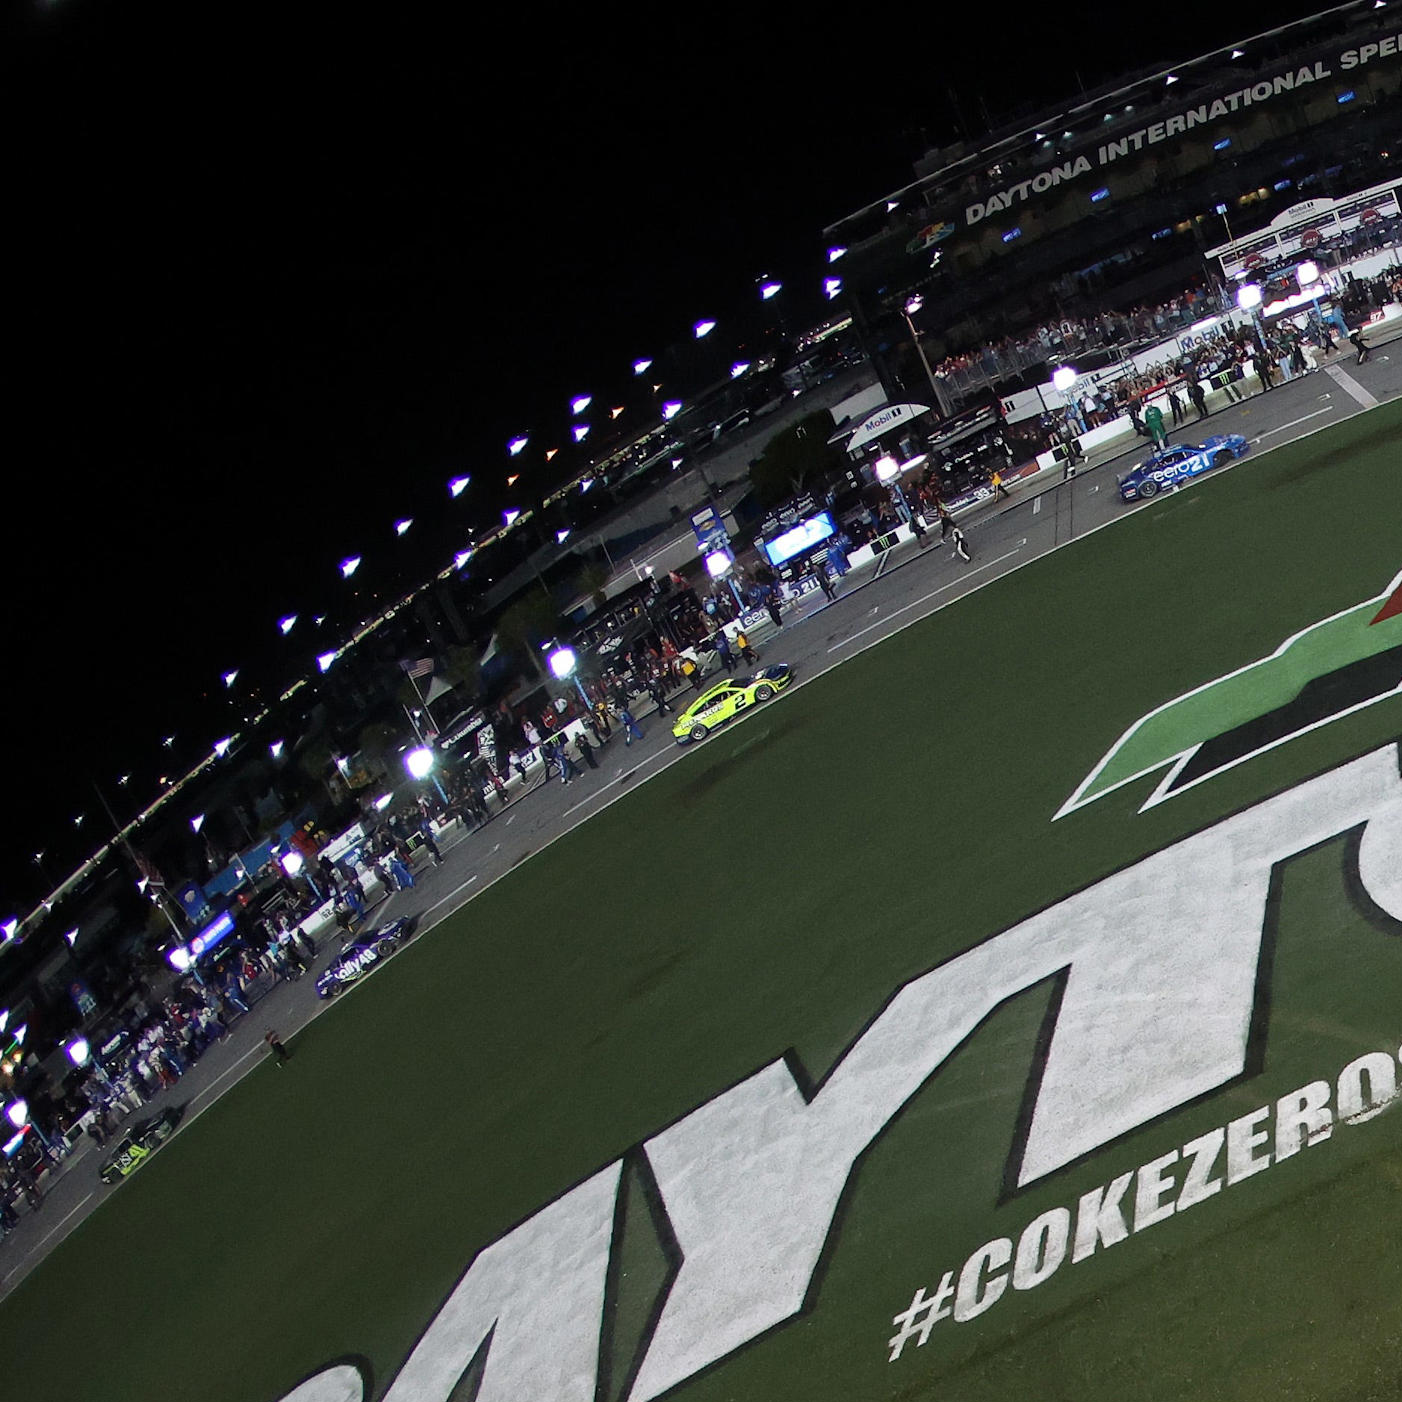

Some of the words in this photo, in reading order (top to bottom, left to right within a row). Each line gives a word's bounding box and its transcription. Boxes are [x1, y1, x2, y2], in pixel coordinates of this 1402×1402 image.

[965, 155, 1092, 226] DAYTONA
[1098, 60, 1333, 166] INTERNATIONAL
[864, 412, 893, 433] Mobil
[1153, 461, 1191, 482] eero
[1190, 454, 1211, 473] 21
[734, 693, 747, 710] 2
